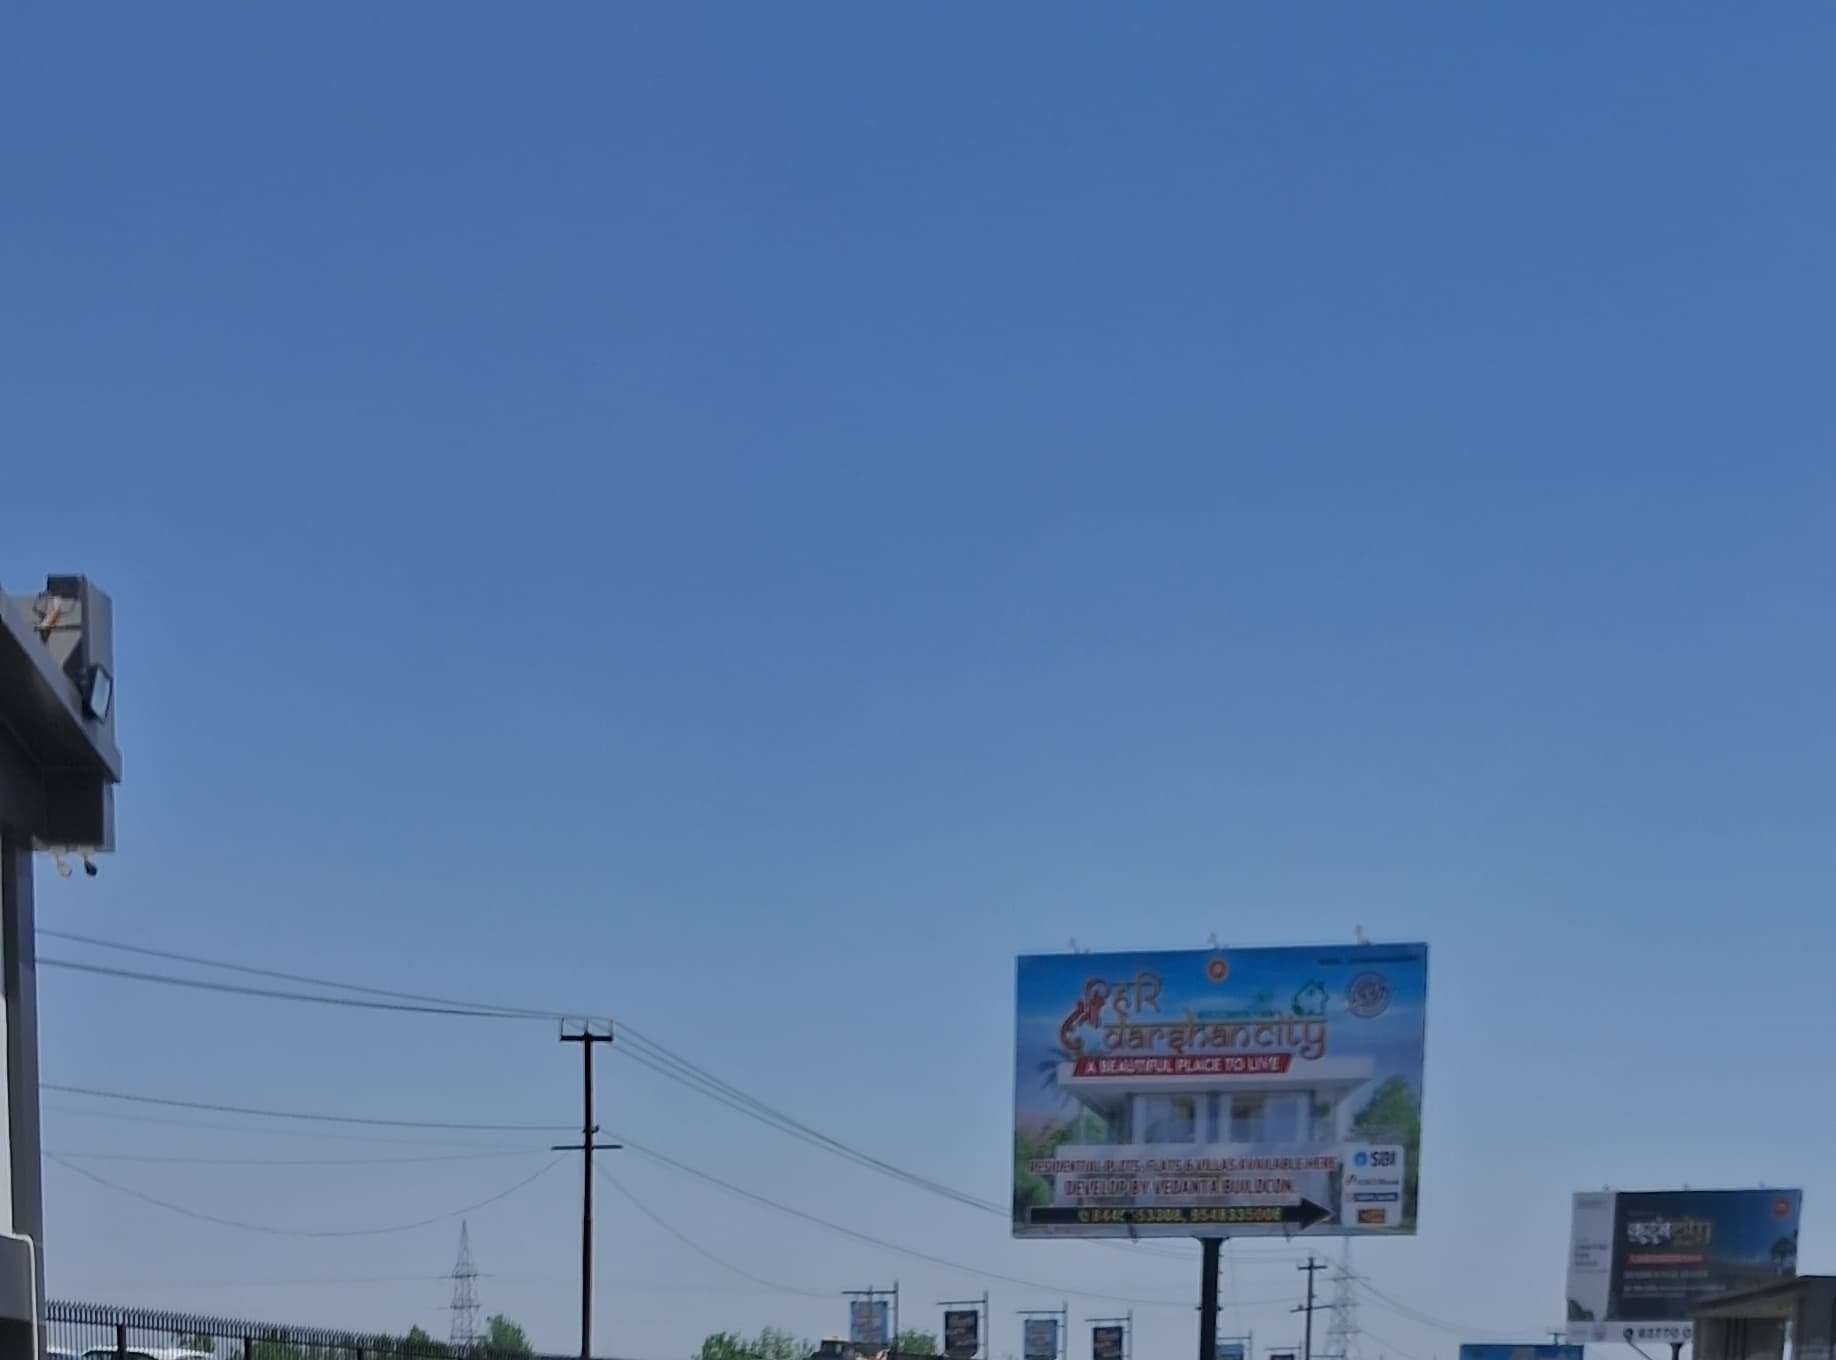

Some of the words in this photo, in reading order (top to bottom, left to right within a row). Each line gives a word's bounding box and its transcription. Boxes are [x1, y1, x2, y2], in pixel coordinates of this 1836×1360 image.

[1102, 1058, 1174, 1073] BEAUTIFUL
[1176, 1058, 1221, 1072] PLACE
[1225, 1057, 1245, 1072] TO
[1249, 1056, 1280, 1071] LIVE
[1370, 1151, 1396, 1167] SBI
